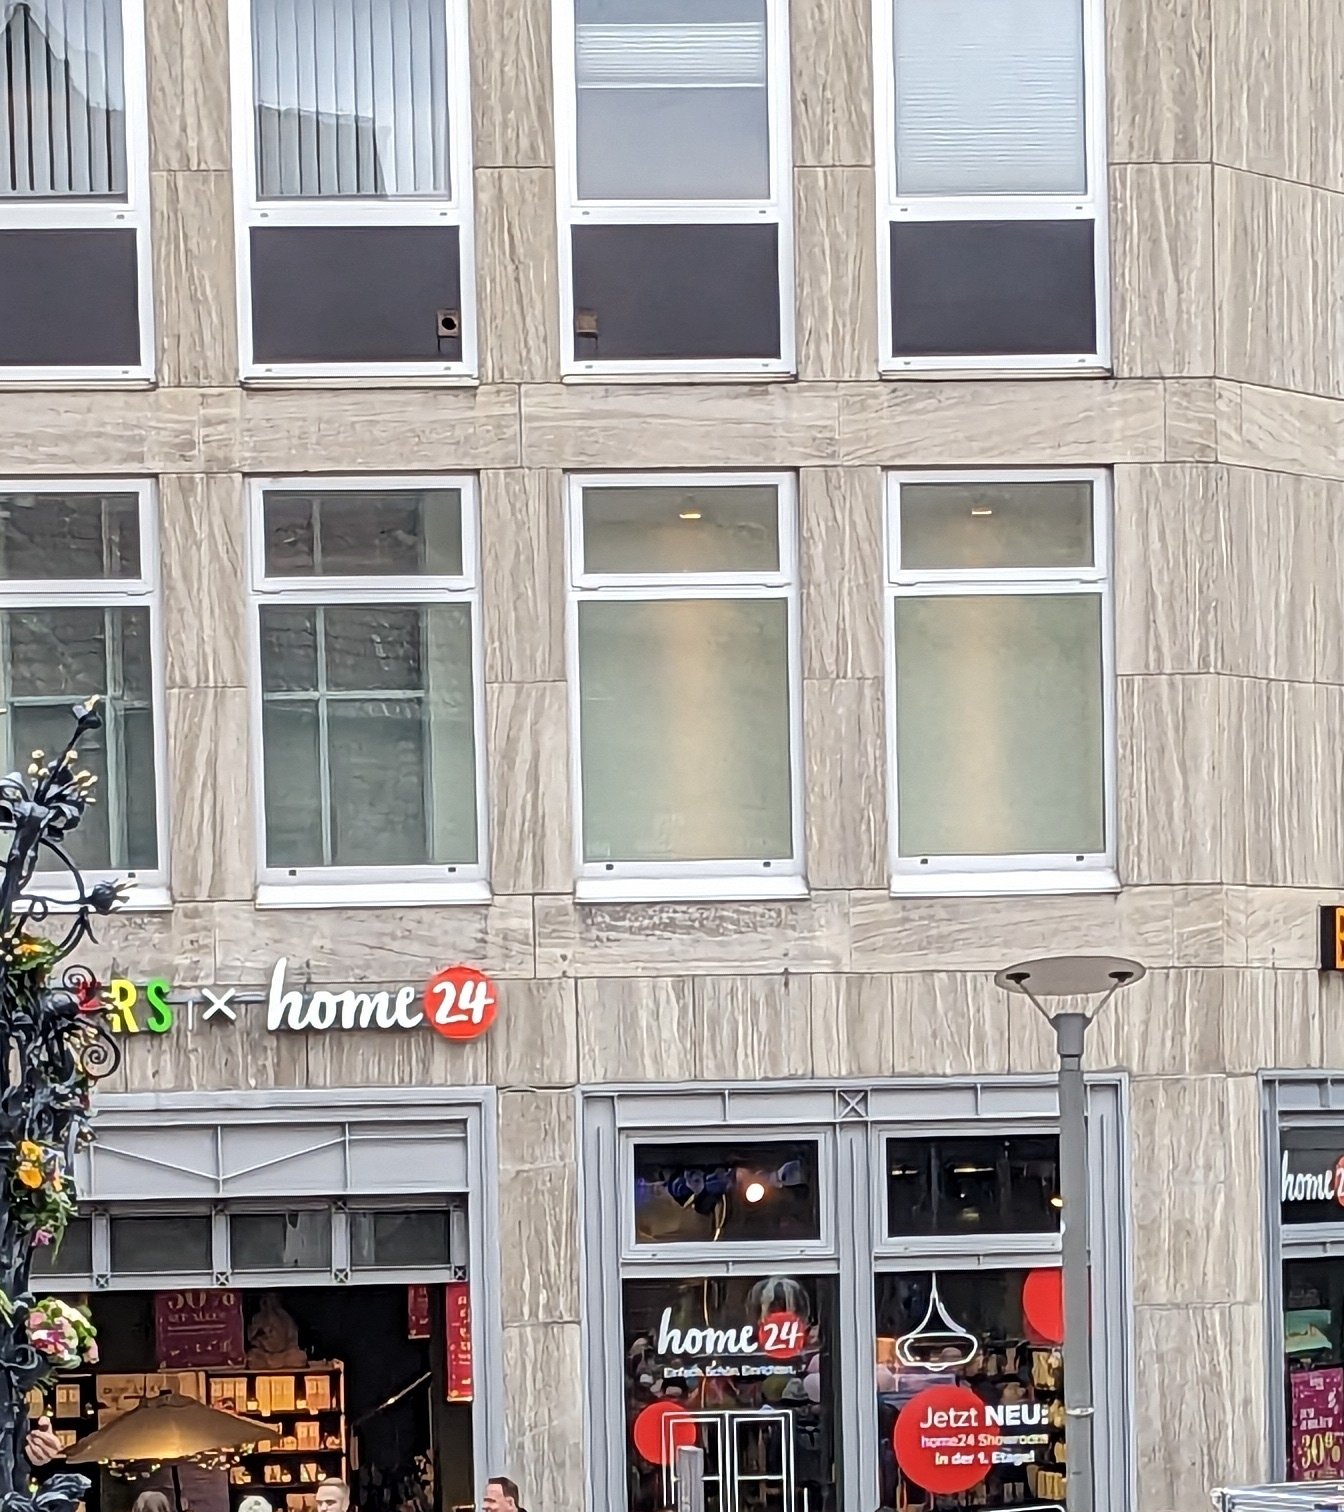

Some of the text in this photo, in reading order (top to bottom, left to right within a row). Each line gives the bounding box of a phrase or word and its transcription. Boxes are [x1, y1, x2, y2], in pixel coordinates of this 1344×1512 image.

[658, 1306, 805, 1355] home24
[920, 1403, 1049, 1429] Jetzt NEU:
